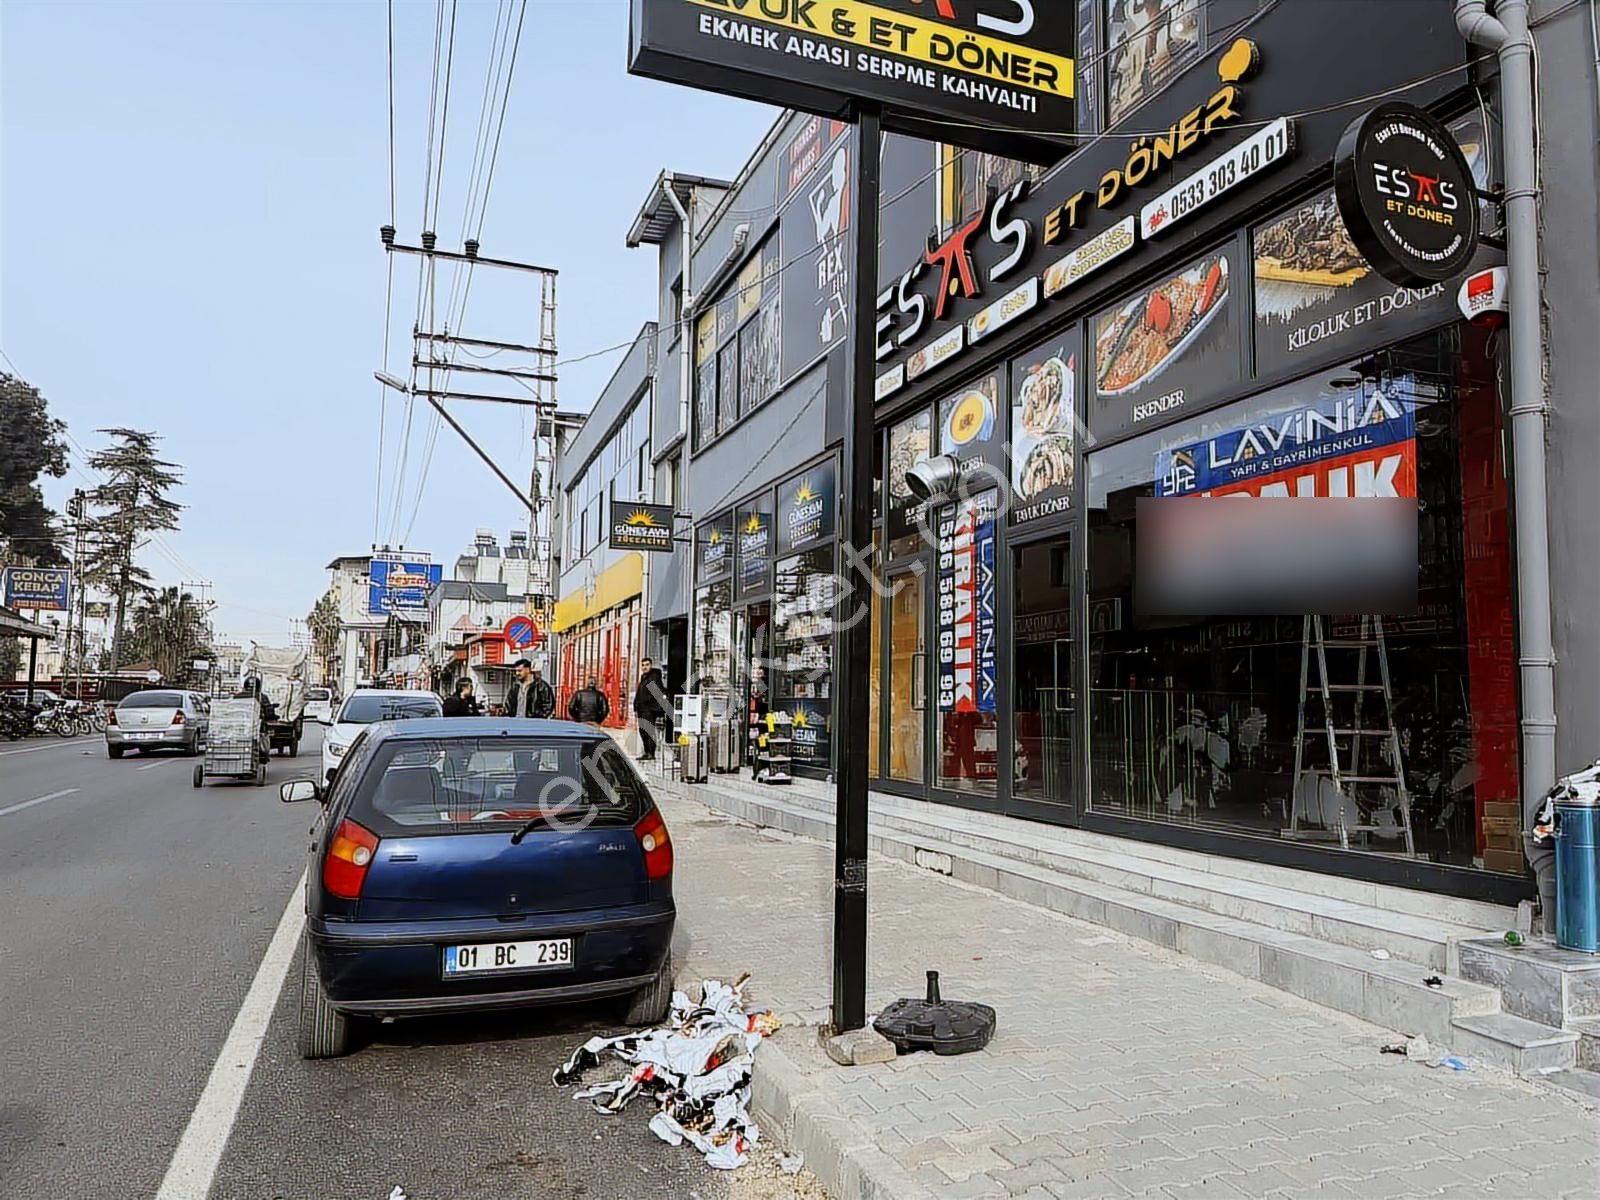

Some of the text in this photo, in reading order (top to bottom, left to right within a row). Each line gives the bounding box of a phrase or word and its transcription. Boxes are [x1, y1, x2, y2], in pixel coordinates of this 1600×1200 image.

[700, 13, 1036, 113] EKMEK ARASI SERPME KAHVALTI
[870, 16, 916, 51] ET
[930, 33, 1058, 90] DÖNER
[1044, 190, 1084, 246] ET
[1097, 85, 1240, 209] DÖNER
[1170, 127, 1285, 220] 0533 303 40 01
[1373, 163, 1458, 210] ESAS
[1386, 199, 1404, 212] ET
[1354, 300, 1376, 325] ET
[1230, 464, 1256, 478] YAPI
[1273, 434, 1373, 468] GAYRİMENKUL
[11, 571, 64, 583] GONCA
[14, 581, 60, 593] KEBAP
[940, 502, 956, 706] 0536 588 69 93
[459, 946, 478, 968] 01
[495, 945, 517, 966] BC
[538, 942, 569, 963] 239
